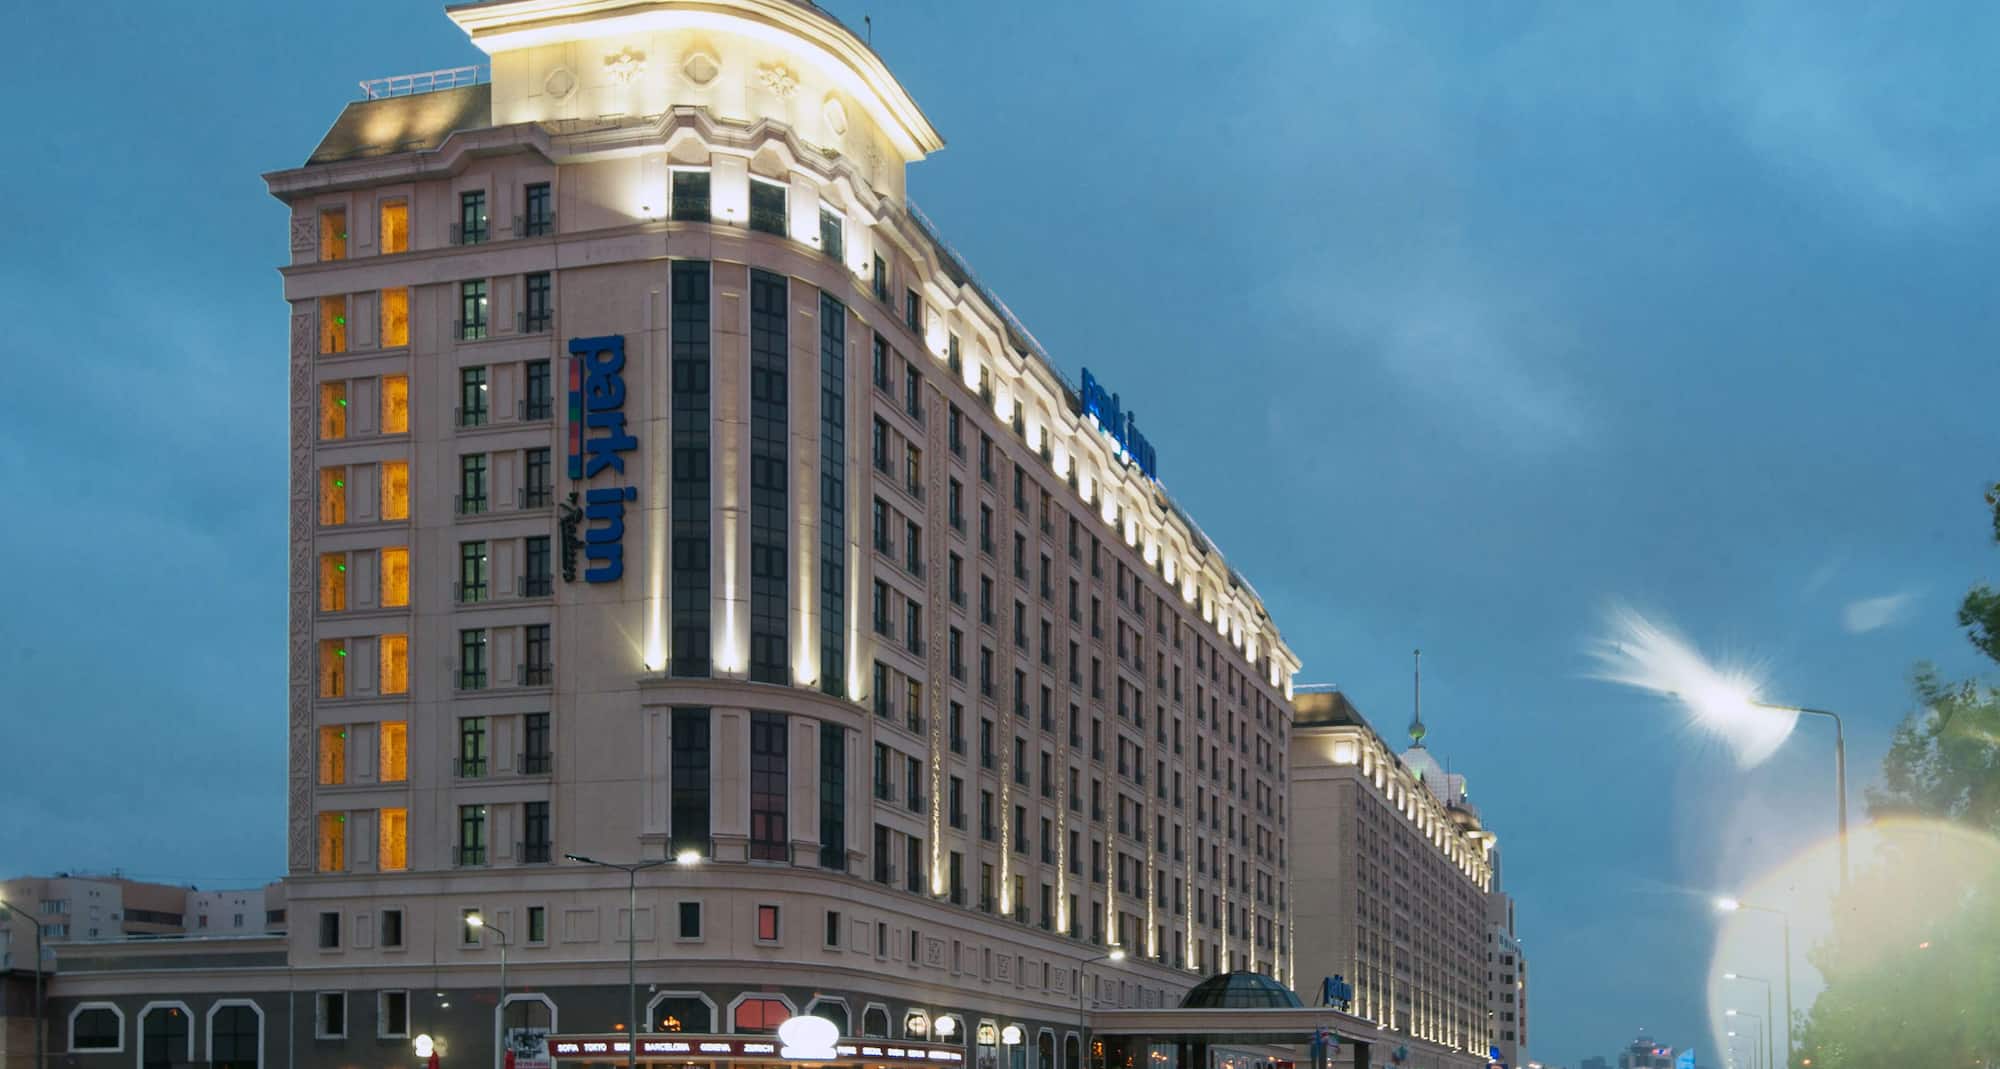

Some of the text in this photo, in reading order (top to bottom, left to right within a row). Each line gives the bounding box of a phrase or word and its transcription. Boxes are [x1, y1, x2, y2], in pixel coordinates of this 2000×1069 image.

[568, 334, 638, 584] park inn
[644, 1042, 690, 1052] BARCELONA
